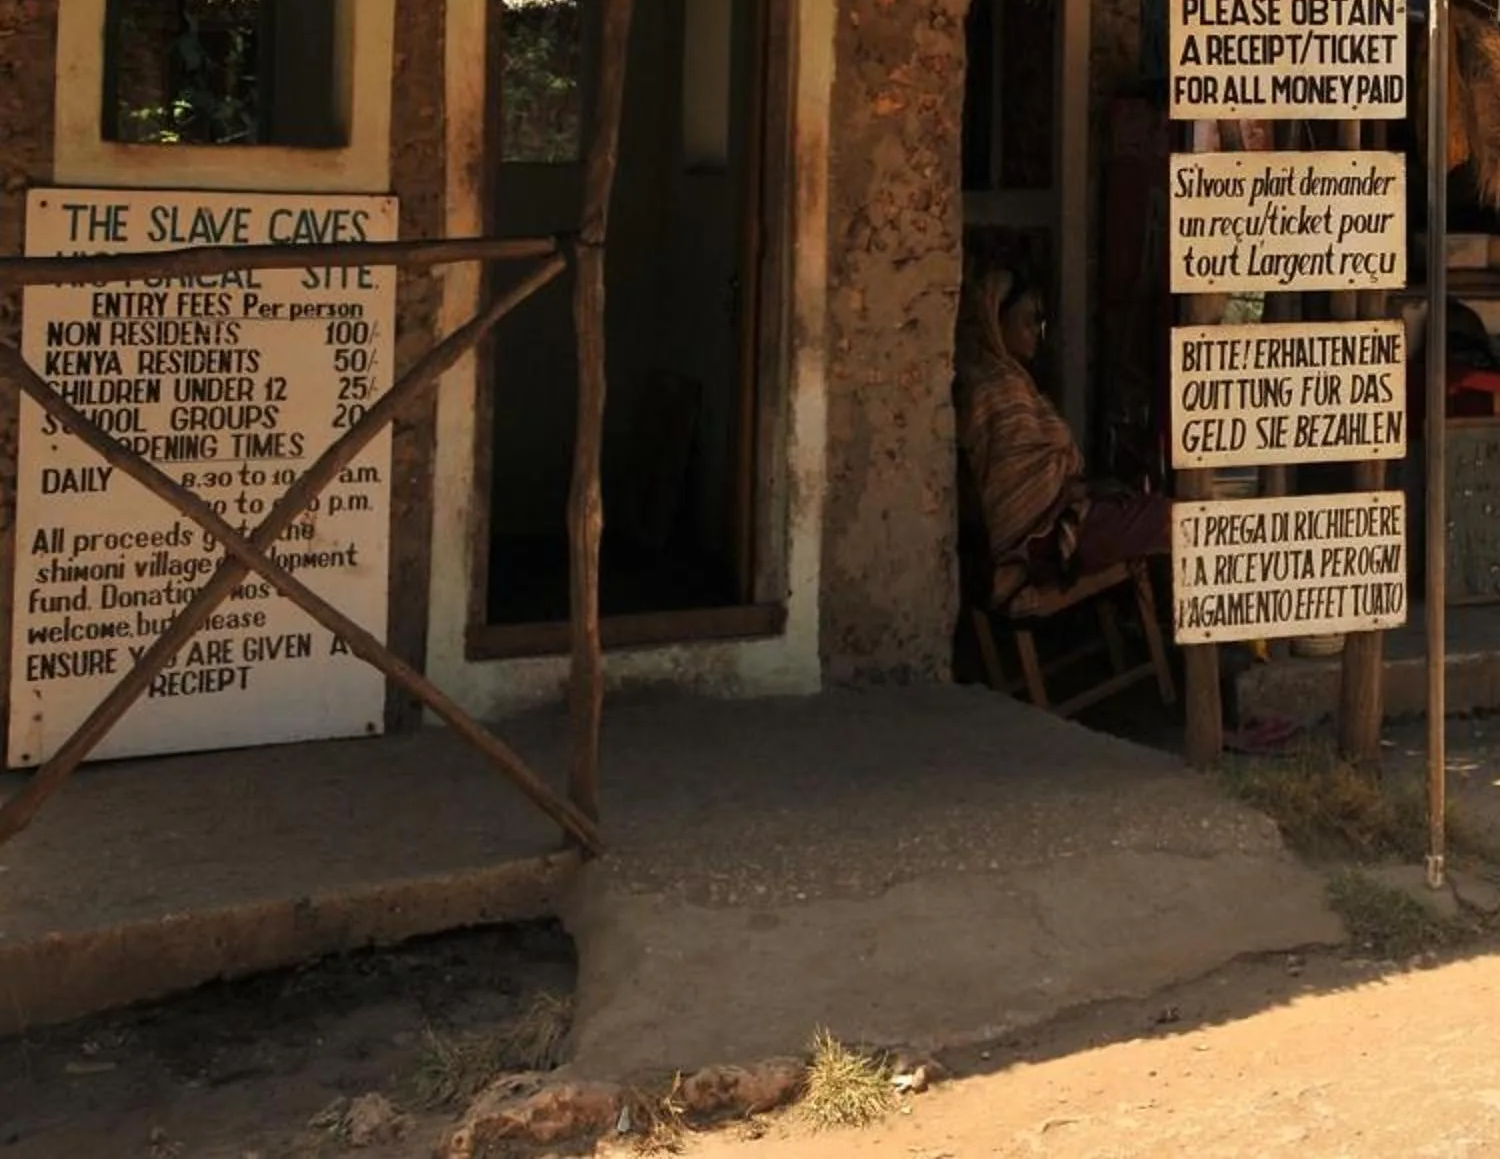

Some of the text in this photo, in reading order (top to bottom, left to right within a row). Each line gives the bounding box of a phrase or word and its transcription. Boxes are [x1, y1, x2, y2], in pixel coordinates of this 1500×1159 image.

[1180, 30, 1397, 66] A RECEIPT/TICKET
[1175, 75, 1404, 104] FOR ALL MONEY PAID
[1299, 165, 1397, 196] demander
[62, 204, 370, 243] THE SLAVE CAVES
[1179, 216, 1206, 237] un
[1337, 213, 1395, 243] pour
[1183, 245, 1241, 278] tout
[1339, 251, 1397, 283] reçu
[92, 292, 364, 322] ENTRY FEES Per person
[47, 321, 101, 346] NON
[110, 321, 242, 346] RESIDENTS
[45, 350, 122, 376] KENYA
[138, 349, 261, 375] RESIDENTS
[1182, 333, 1402, 372] BITTE! ERHALTEN EINE
[174, 377, 255, 403] UNDER
[264, 377, 287, 401] 12
[1182, 370, 1394, 411] QUITTUNG FÜR DAS
[171, 404, 279, 431] GROUPS
[1182, 410, 1404, 454] GELD SIE BEZAHLEN
[231, 432, 305, 458] TIMES
[42, 467, 113, 494] DAILY
[238, 462, 266, 486] to
[234, 490, 264, 514] to
[31, 527, 65, 555] All
[73, 521, 193, 558] proceeds
[1204, 513, 1267, 547] PREGA
[1271, 512, 1289, 543] DI
[1293, 504, 1402, 542] RICHIEDERE
[135, 549, 212, 581] village
[1213, 548, 1315, 586] RICEVUTA
[27, 648, 118, 681] ENSURE
[186, 639, 234, 667] ARE
[243, 633, 311, 662] GIVEN
[329, 635, 348, 655] A
[149, 666, 253, 697] RECIEPT
